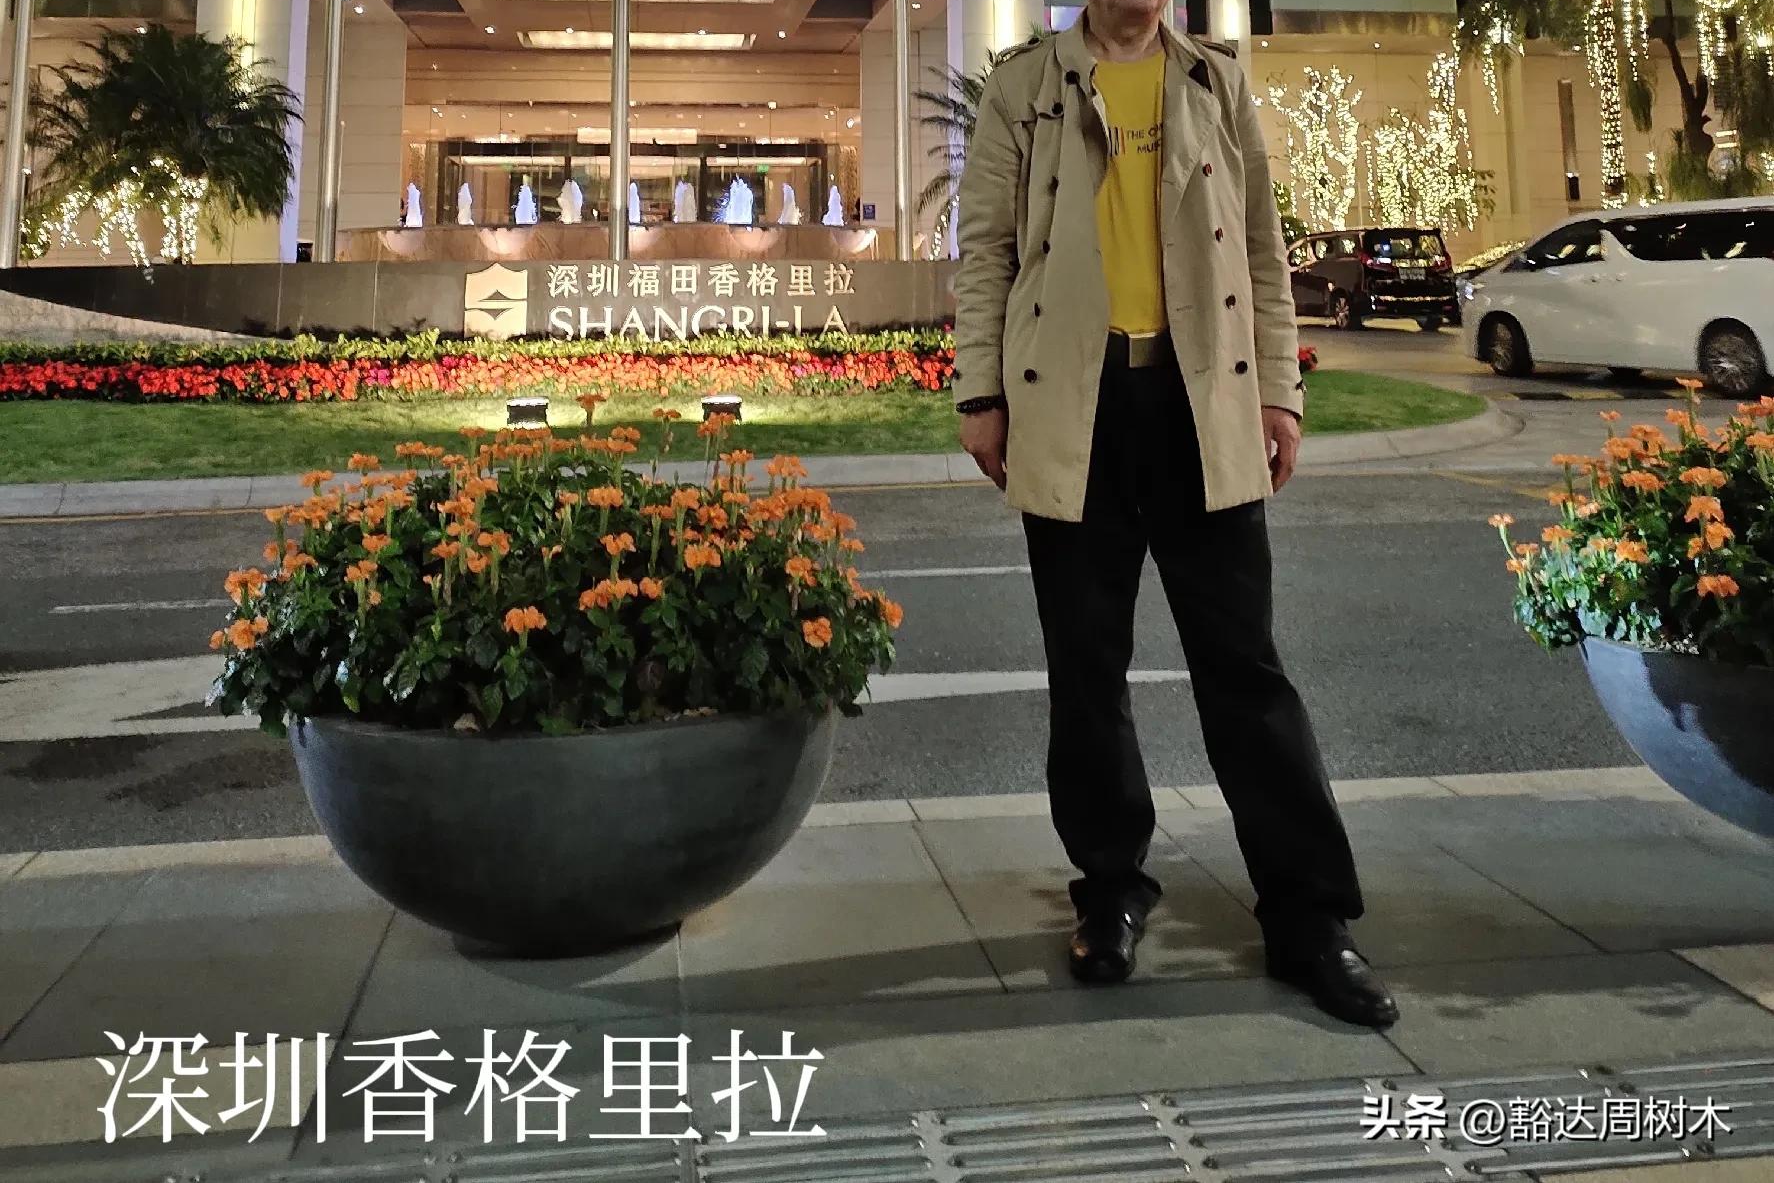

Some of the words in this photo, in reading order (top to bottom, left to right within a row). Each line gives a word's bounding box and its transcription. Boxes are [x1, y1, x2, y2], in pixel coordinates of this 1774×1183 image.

[547, 263, 855, 297] 深圳福田香格里拉
